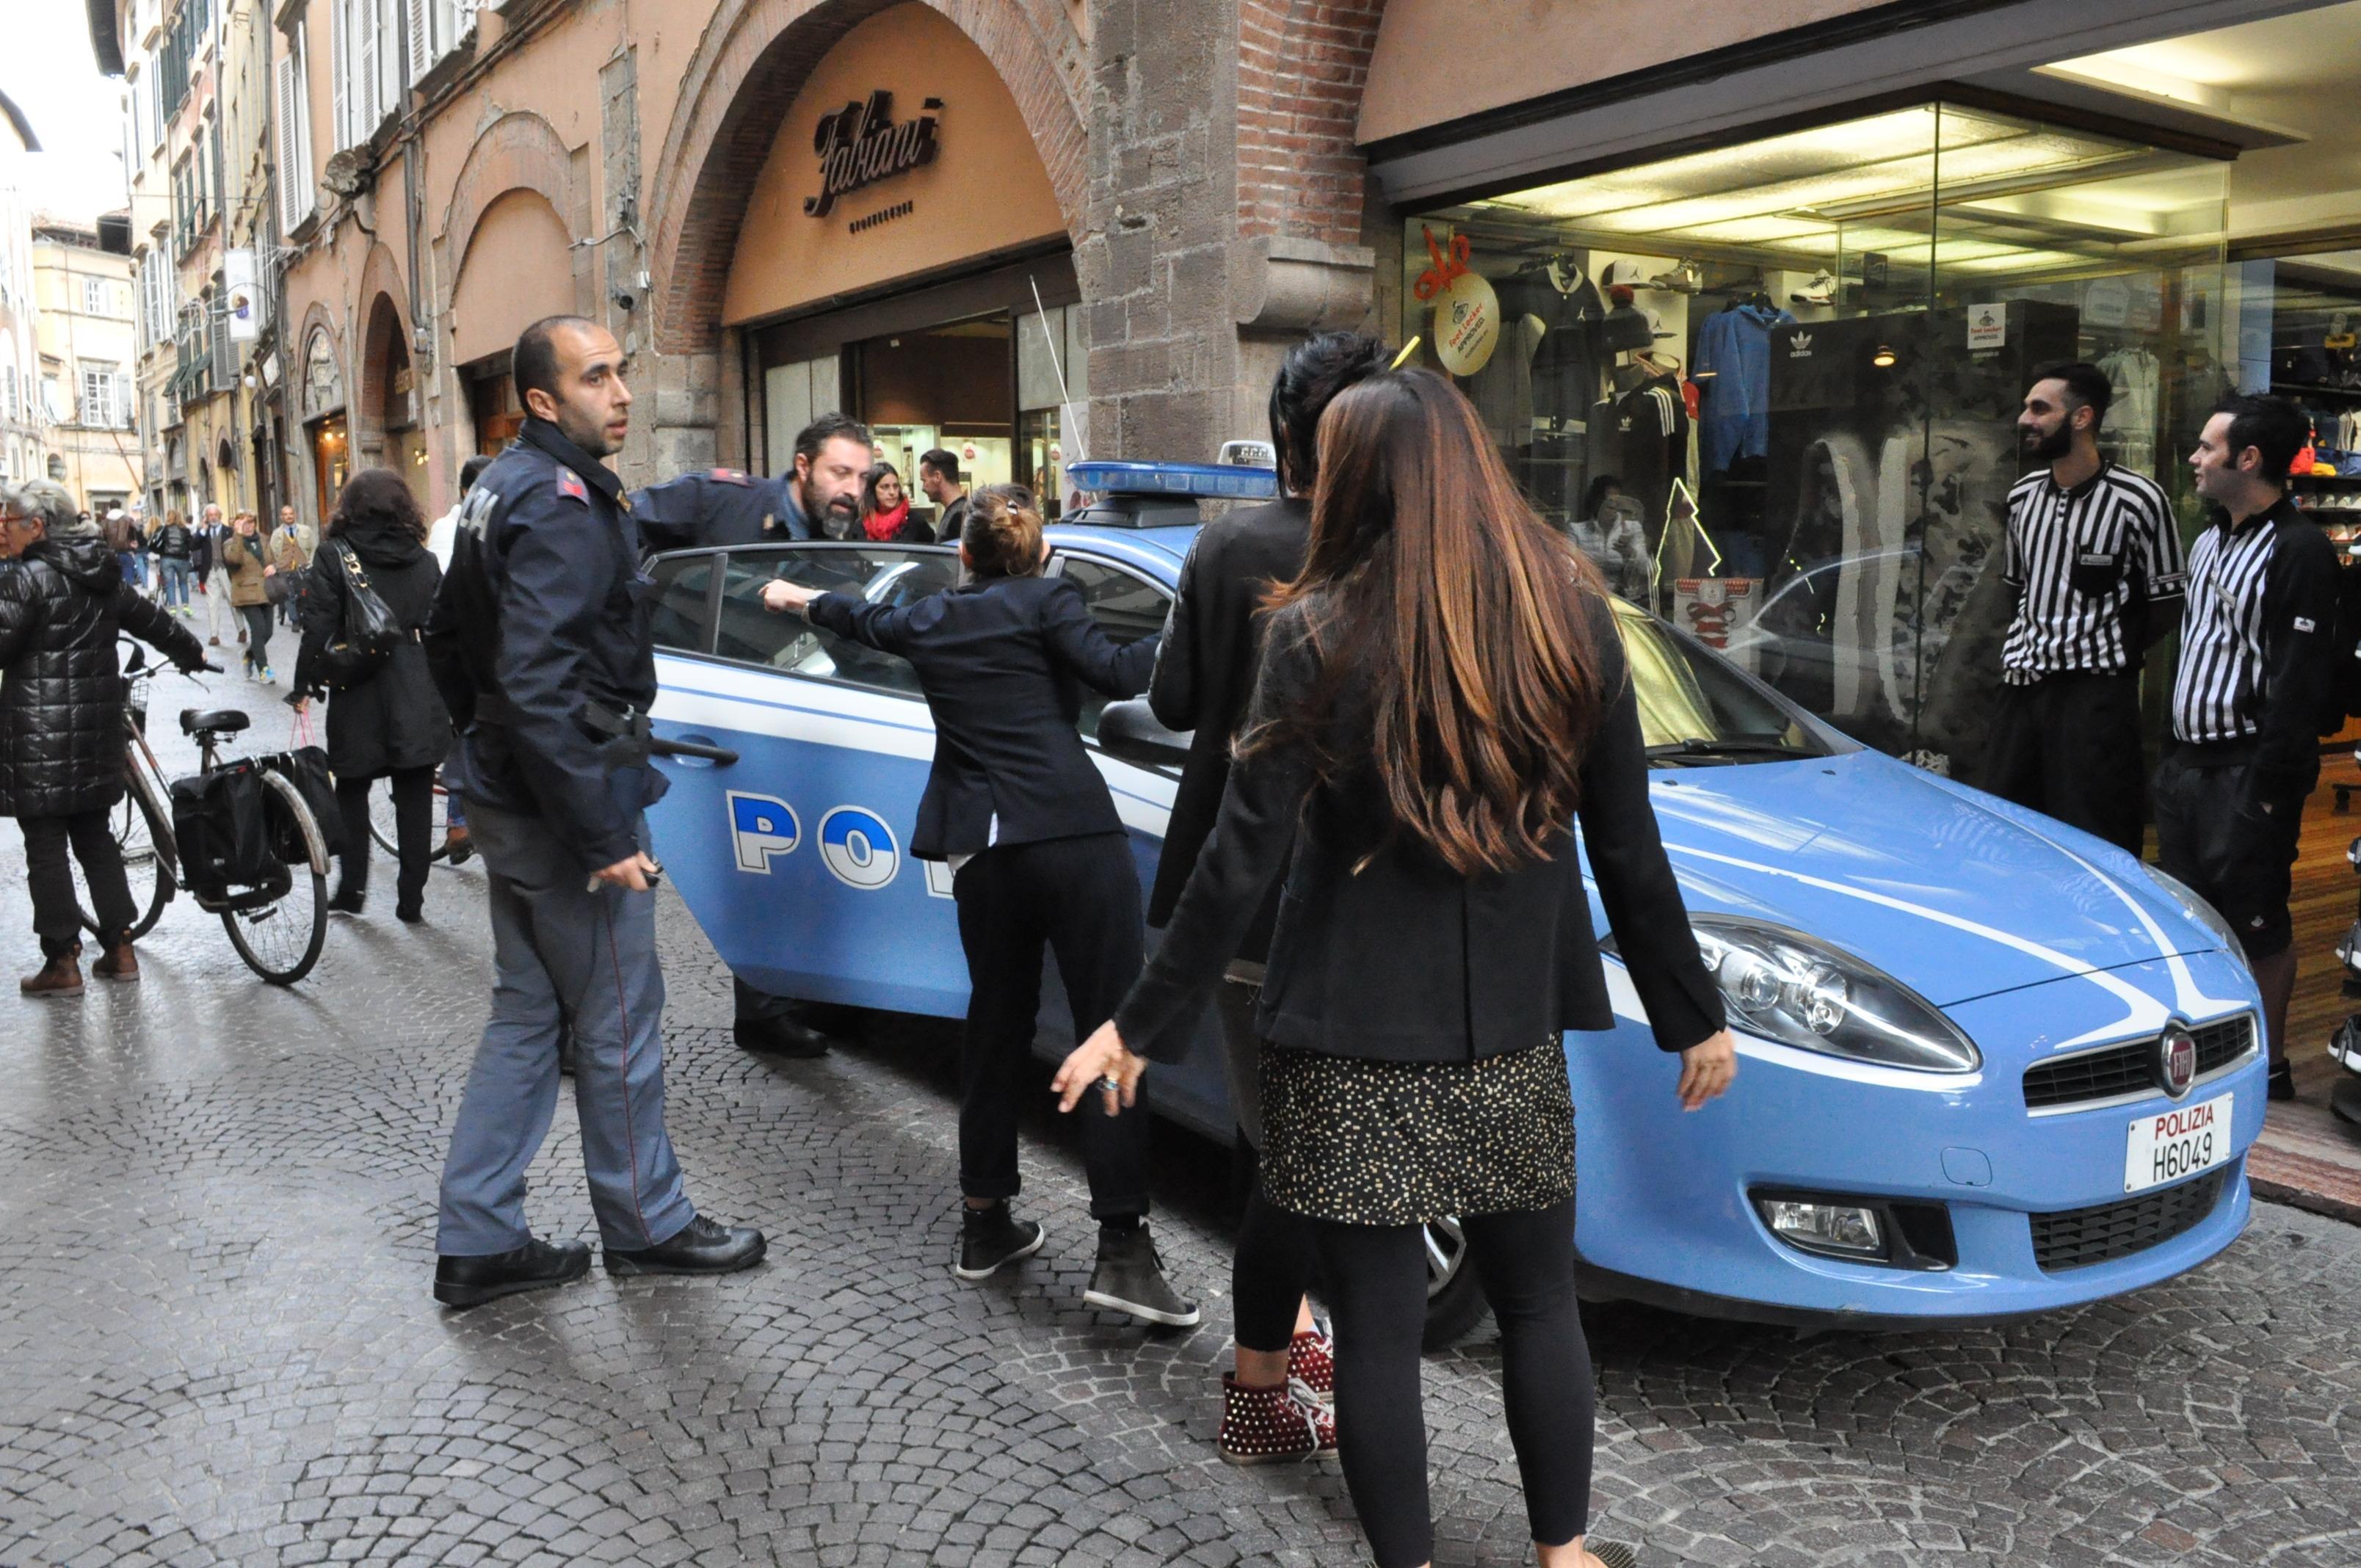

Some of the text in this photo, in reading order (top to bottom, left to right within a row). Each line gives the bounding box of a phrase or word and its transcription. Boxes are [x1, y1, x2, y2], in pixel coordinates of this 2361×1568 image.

[804, 90, 945, 218] Fabiani
[2173, 1050, 2192, 1078] FIAT
[2155, 1103, 2214, 1140] POLIZIA
[2153, 1131, 2213, 1183] H6049
